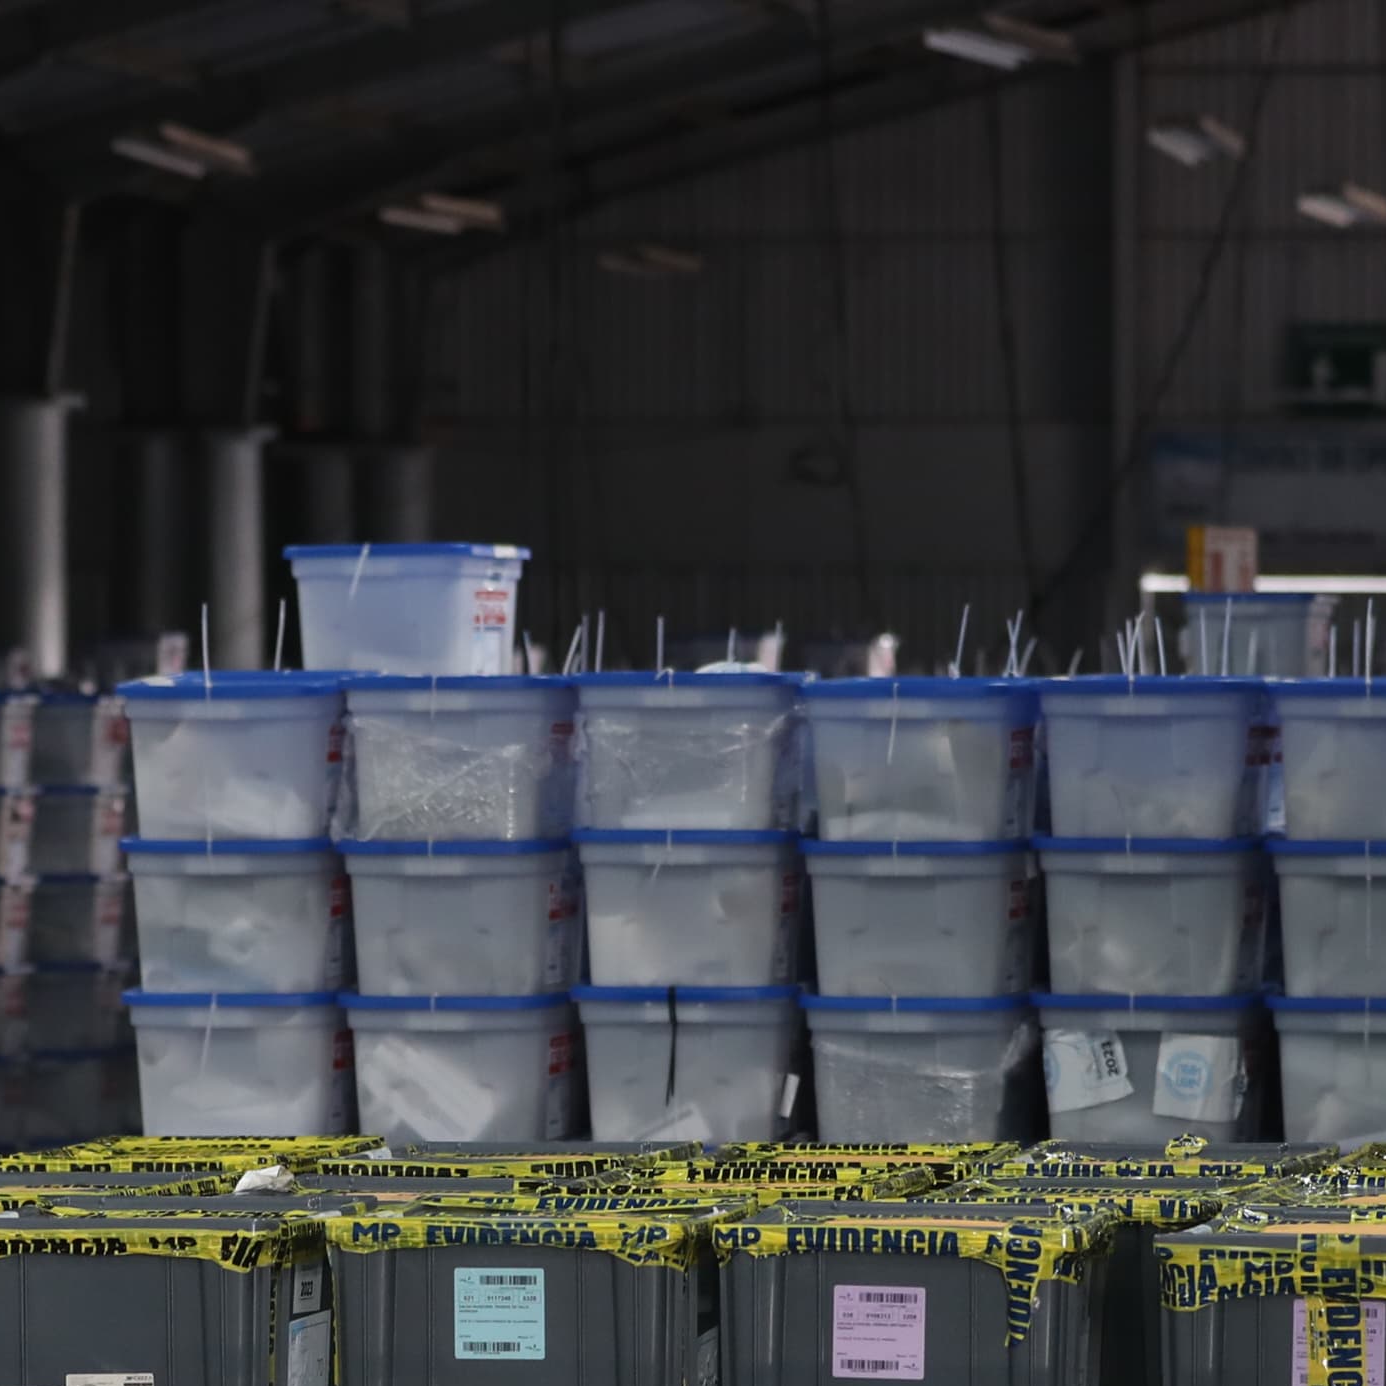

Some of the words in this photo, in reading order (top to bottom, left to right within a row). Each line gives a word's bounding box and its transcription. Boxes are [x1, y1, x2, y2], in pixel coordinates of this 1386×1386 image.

[353, 1222, 402, 1243] MP
[426, 1224, 597, 1249] EVIDENCIA
[715, 1227, 761, 1248] MP
[788, 1227, 959, 1255] EVIDENCIA
